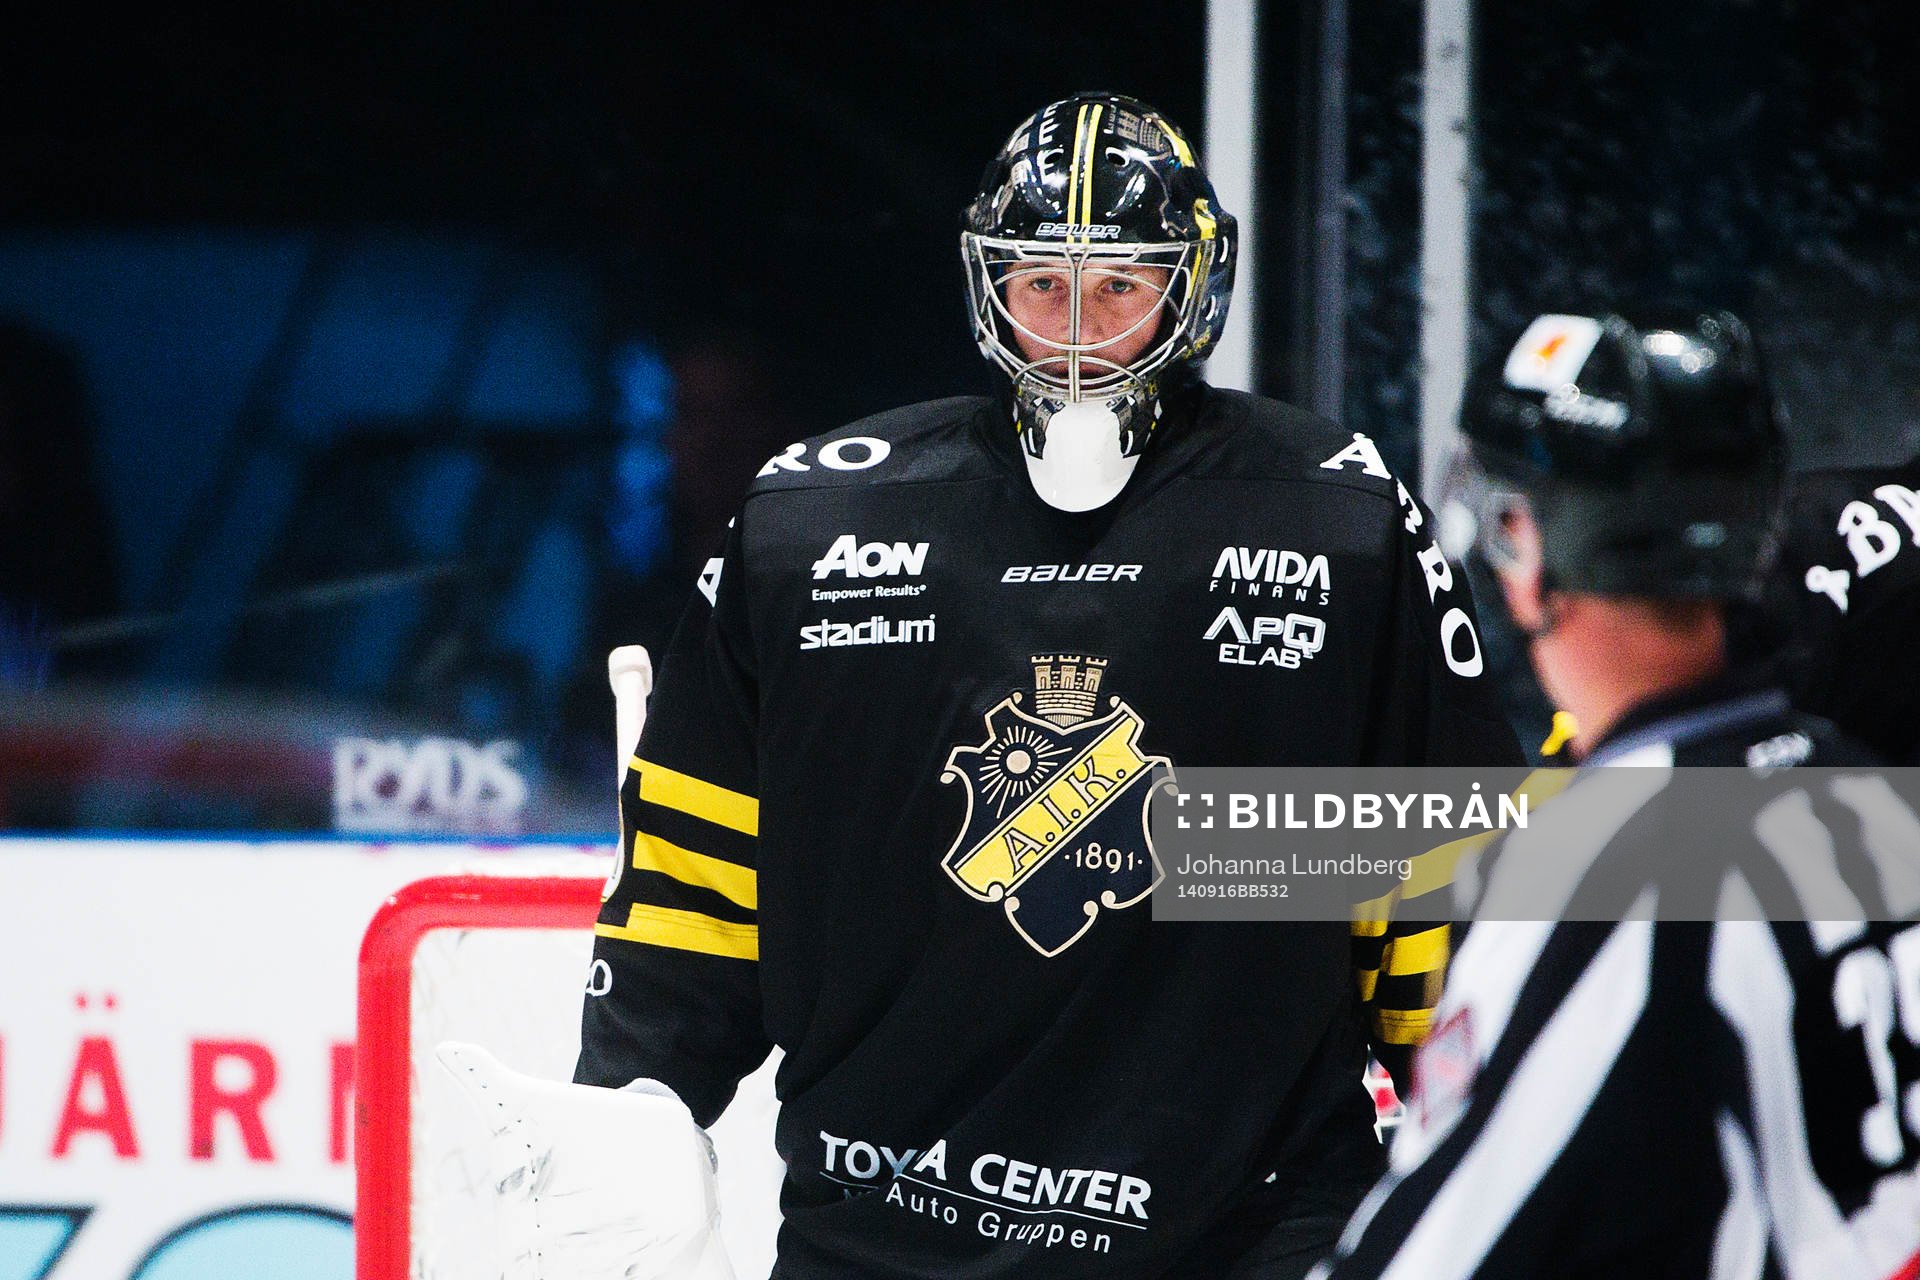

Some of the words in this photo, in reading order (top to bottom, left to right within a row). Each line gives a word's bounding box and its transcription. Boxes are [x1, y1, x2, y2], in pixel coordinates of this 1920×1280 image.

[1035, 222, 1122, 240] BAUER
[1000, 563, 1144, 583] BAUER
[1211, 546, 1331, 591] AVIDA
[811, 588, 873, 603] Empower
[1209, 579, 1331, 606] FINANS
[800, 613, 936, 650] stadium
[1202, 606, 1327, 660] APQ
[1218, 643, 1301, 670] ELAB
[1002, 755, 1127, 877] A.I.K.
[970, 1153, 1152, 1220] CENTER
[885, 1182, 958, 1225] Auto
[977, 1211, 1112, 1254] Gruppen
